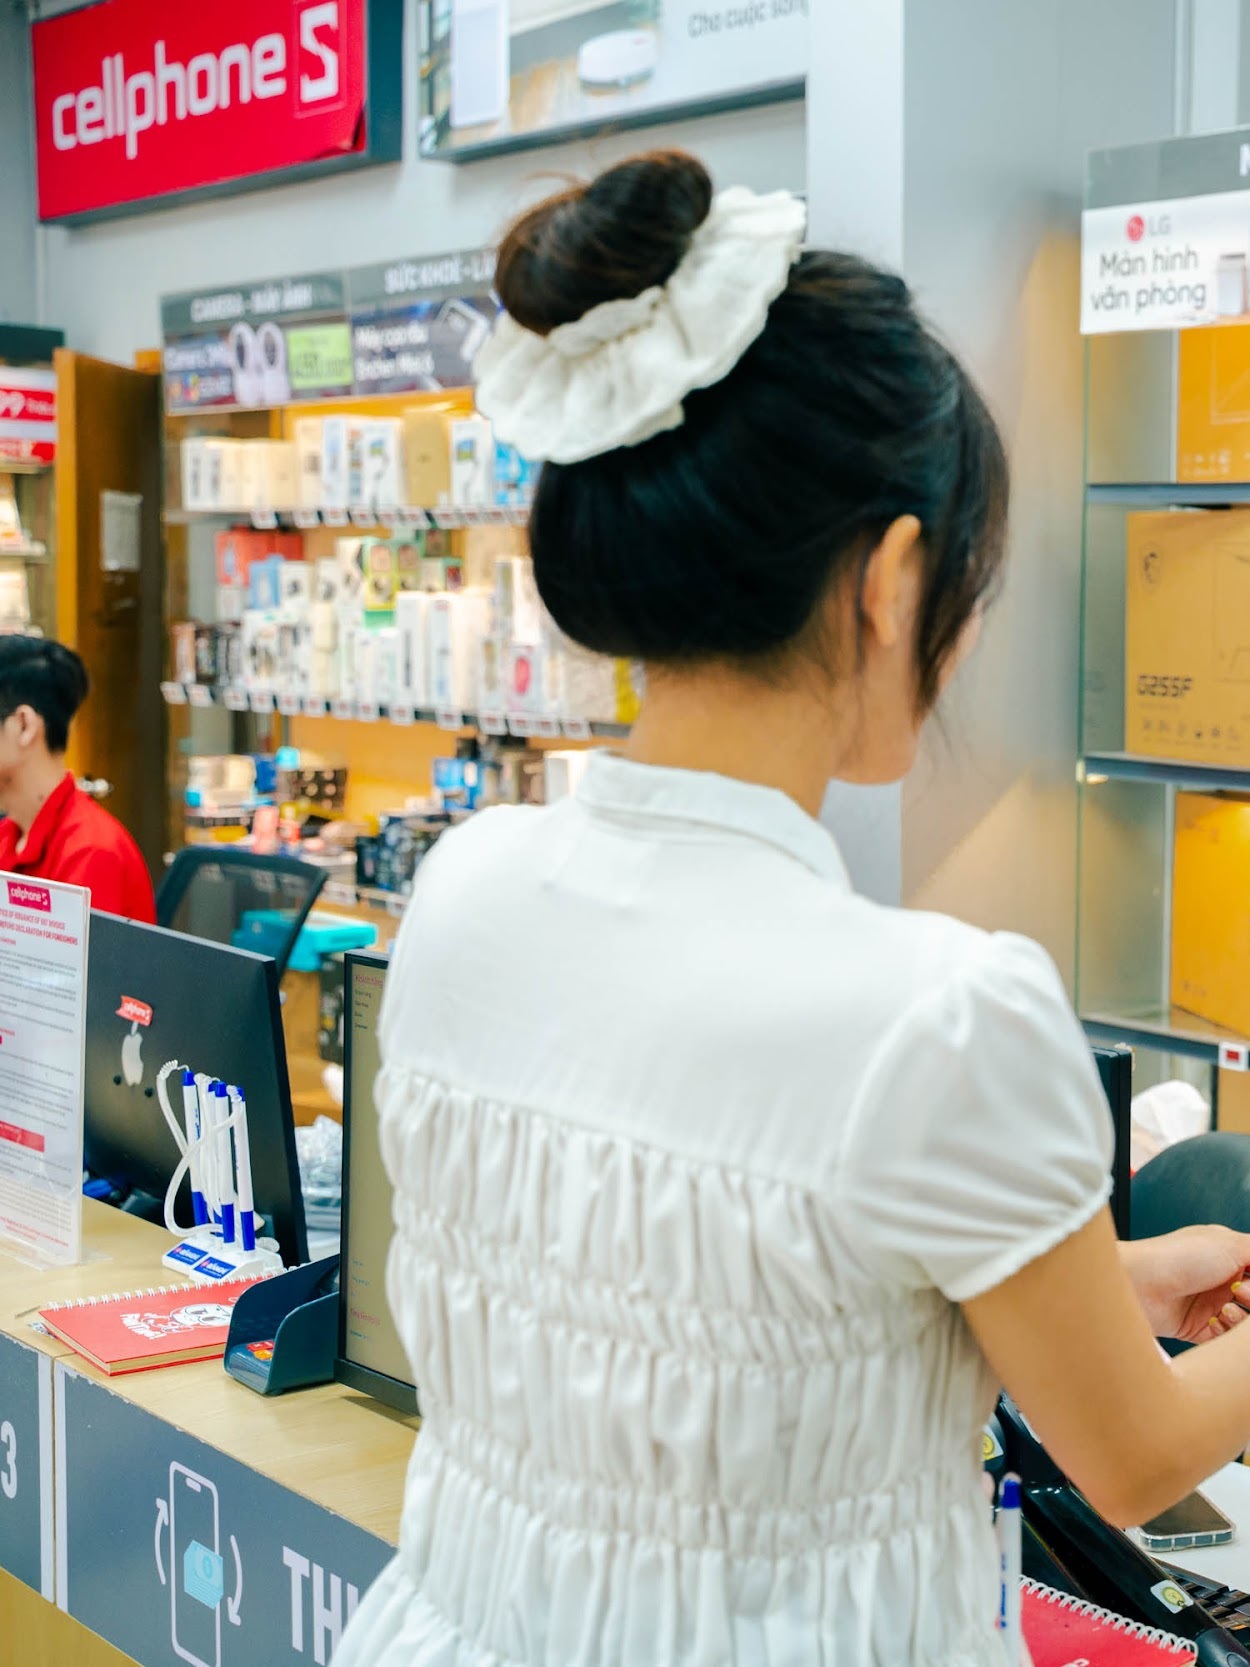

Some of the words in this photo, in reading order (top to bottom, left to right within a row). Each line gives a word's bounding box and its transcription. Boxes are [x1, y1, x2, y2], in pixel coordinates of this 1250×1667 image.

[1148, 215, 1171, 237] LG
[1100, 252, 1146, 279] Màn
[1152, 245, 1198, 274] hình
[1090, 286, 1130, 311] văn
[1134, 282, 1206, 314] phòng
[1, 1420, 17, 1499] 3
